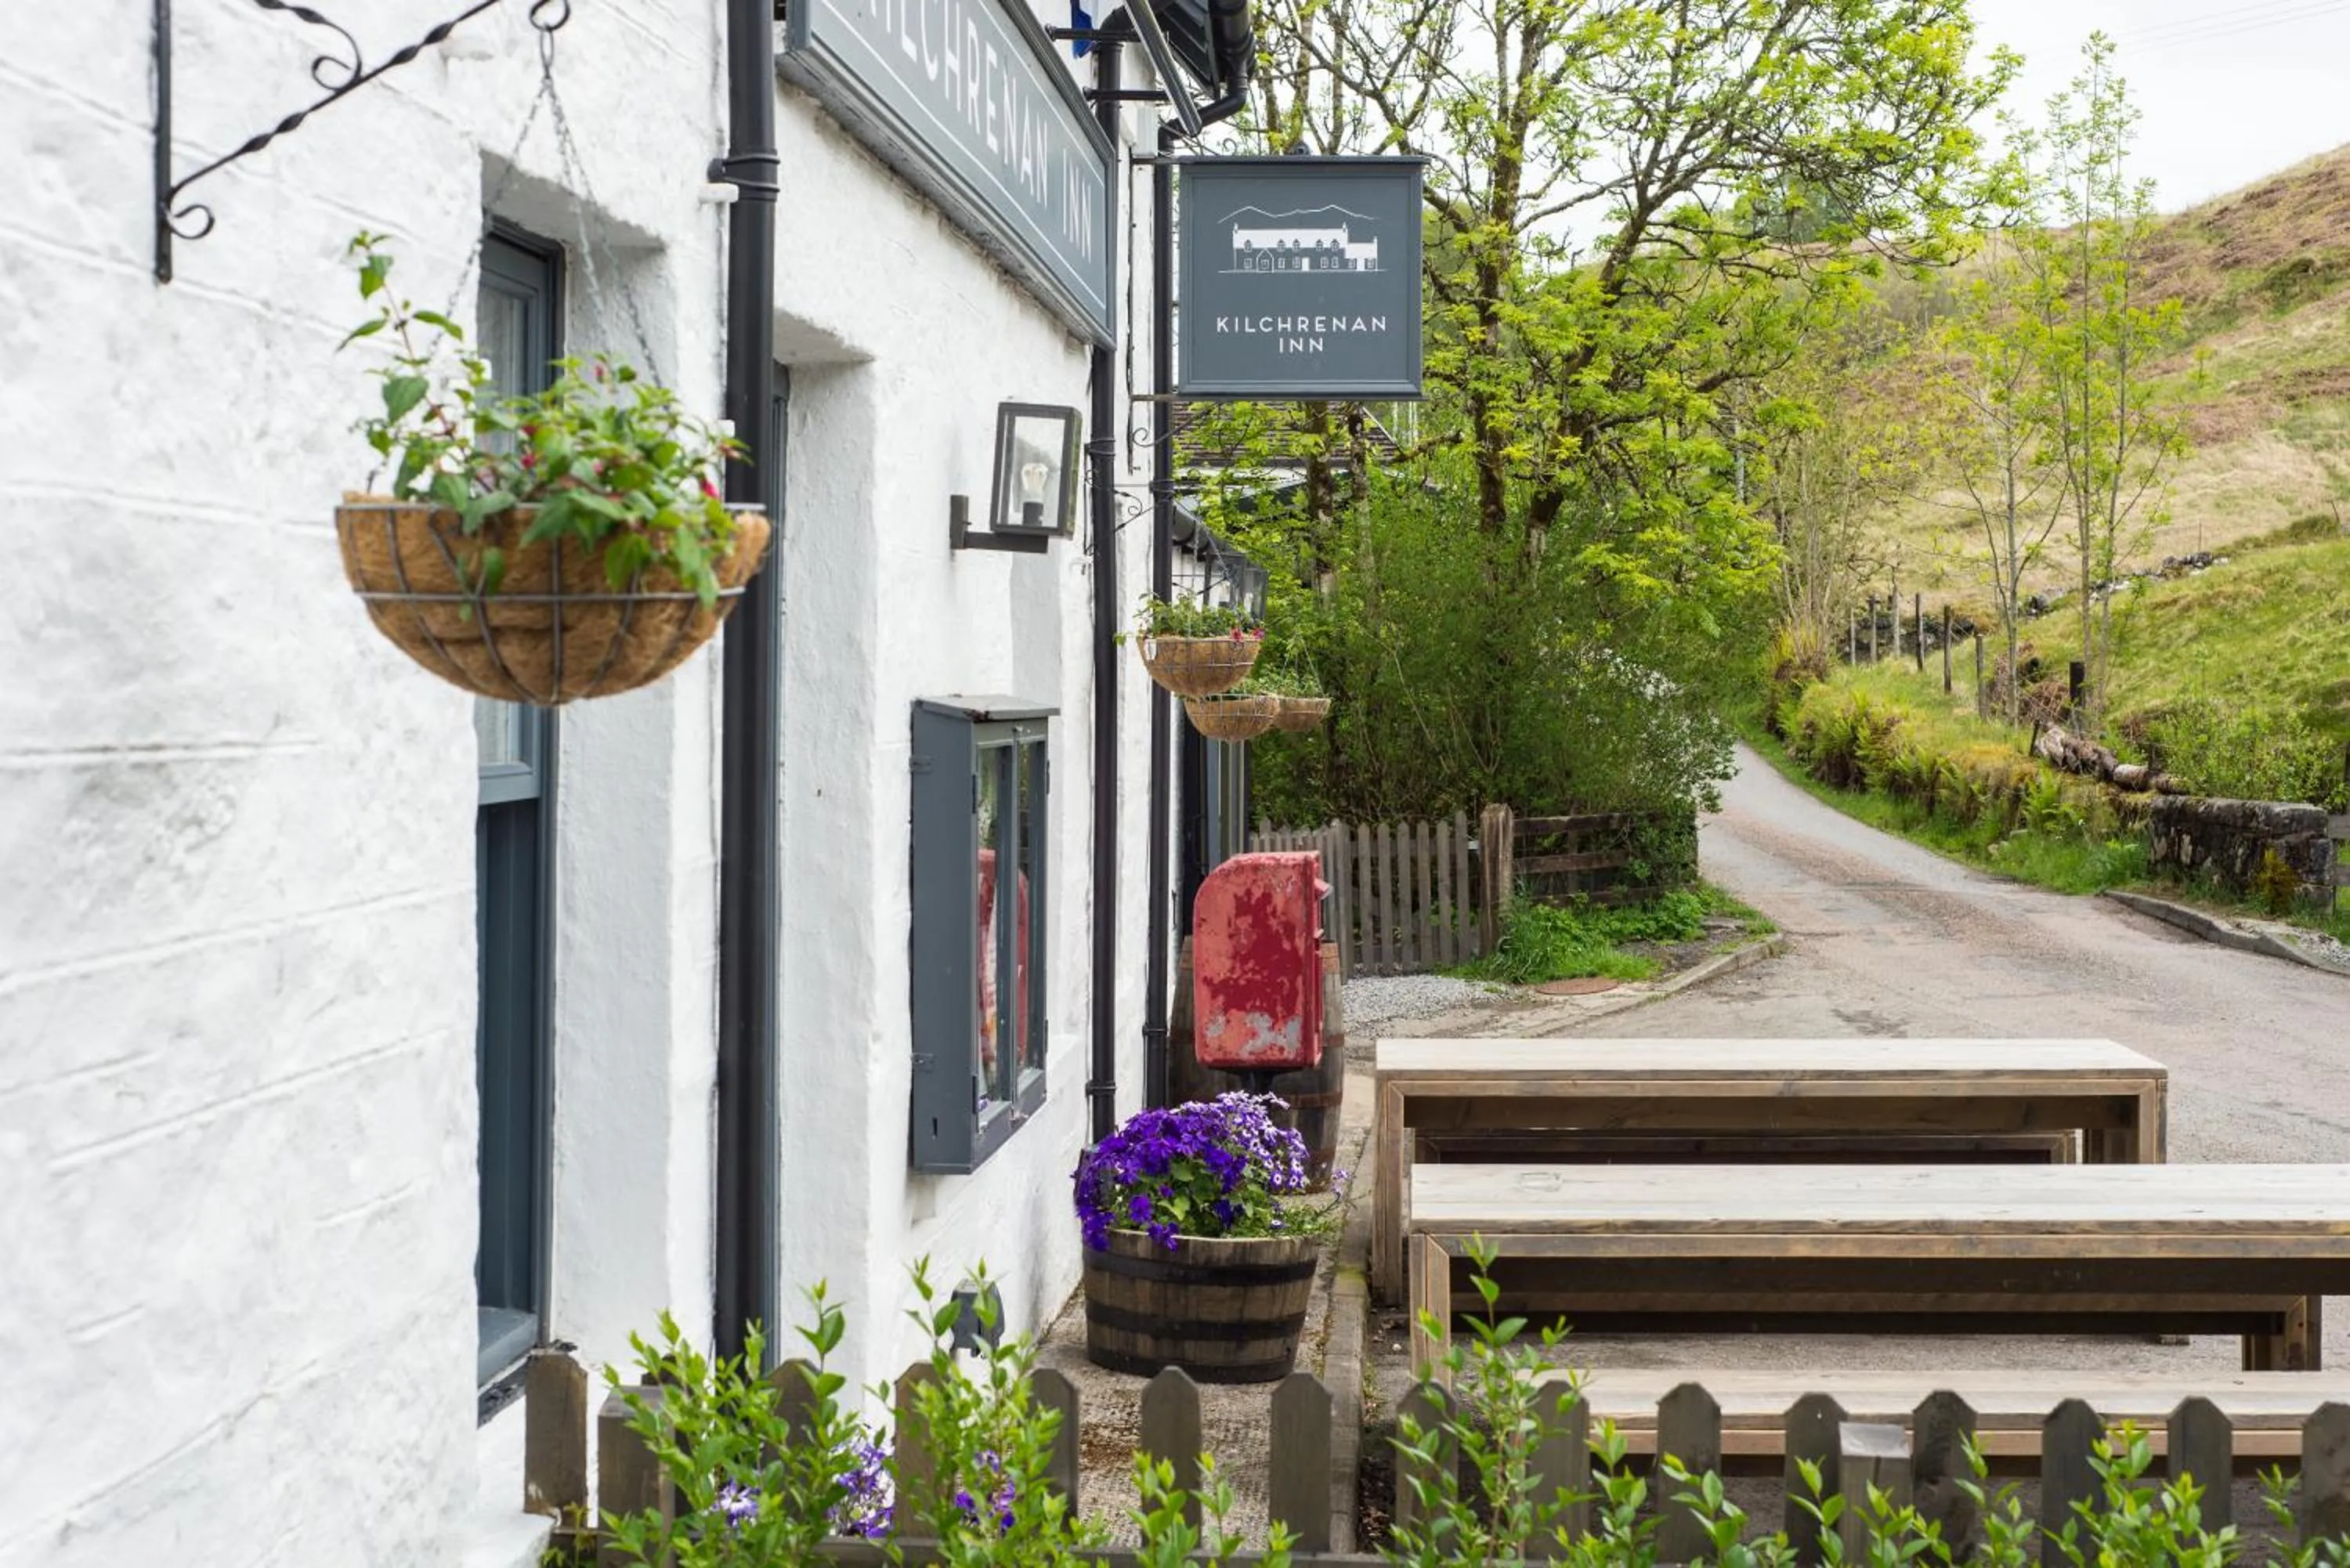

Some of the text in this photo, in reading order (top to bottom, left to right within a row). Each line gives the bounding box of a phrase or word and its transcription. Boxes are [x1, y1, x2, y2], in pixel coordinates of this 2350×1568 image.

[870, 0, 1092, 264] LCHRENAN INN
[1216, 316, 1386, 333] KILCHRENAN
[1278, 337, 1324, 353] INN
